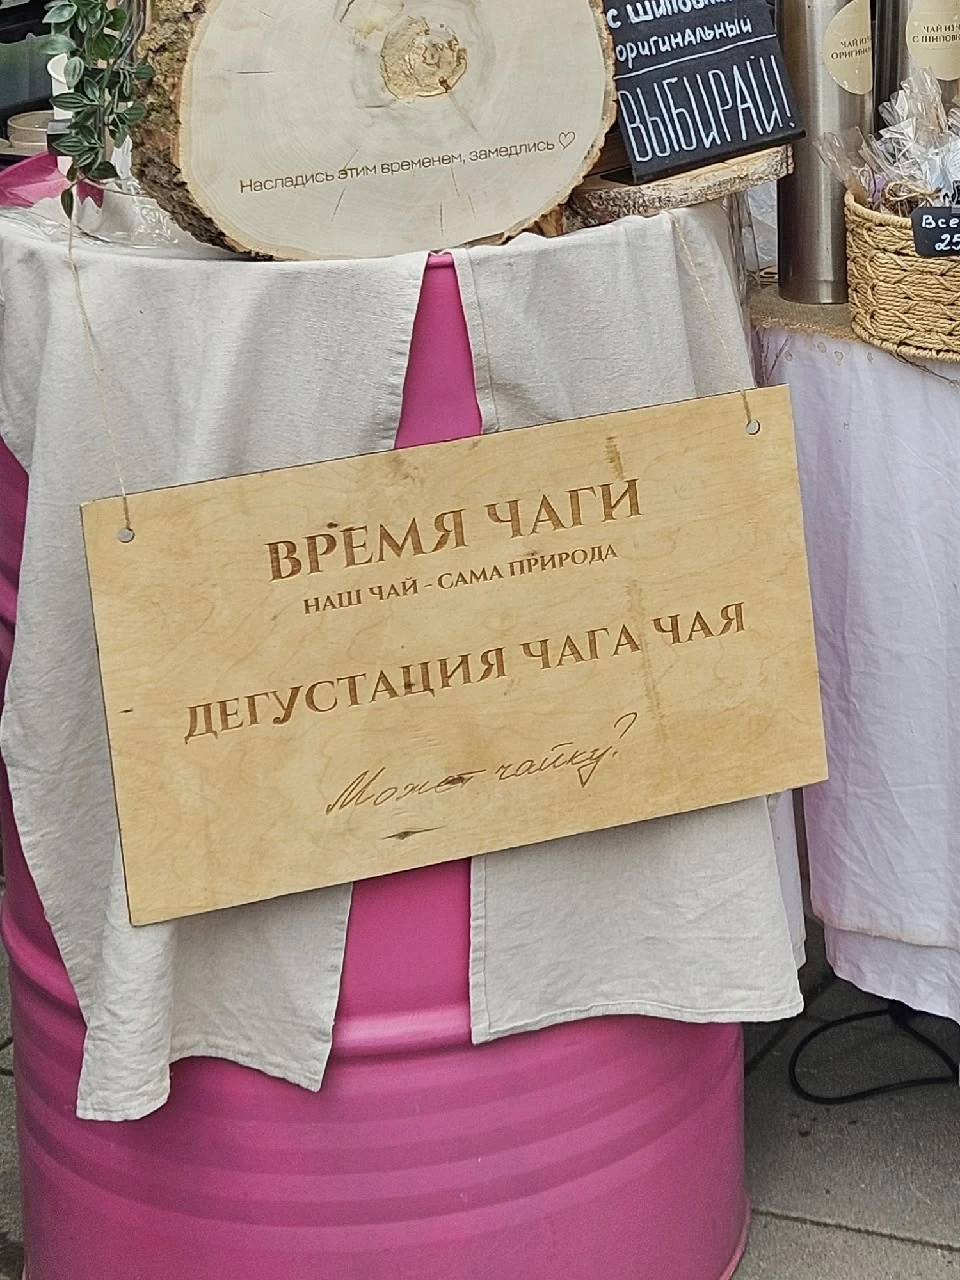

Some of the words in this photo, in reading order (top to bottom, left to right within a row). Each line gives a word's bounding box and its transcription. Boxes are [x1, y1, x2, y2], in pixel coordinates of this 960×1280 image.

[617, 54, 796, 162] ВЫБИРАЙ!
[239, 170, 334, 194] Насладись
[337, 163, 377, 180] этим
[380, 152, 466, 176] временем,
[469, 140, 556, 162] замедлись
[921, 214, 960, 229] Все
[264, 508, 469, 583] ВРЕМЯ
[484, 477, 643, 539] ЧАГИ
[303, 587, 363, 615] НАШ
[368, 576, 418, 602] ЧАЙ
[436, 564, 504, 591] САМА
[507, 543, 619, 578] ПРИРОДА
[184, 646, 508, 745] ДЕГУСТАЦИЯ
[520, 622, 642, 670] ЧАГА
[652, 601, 747, 647] ЧАЯ
[494, 711, 640, 788] чайку?
